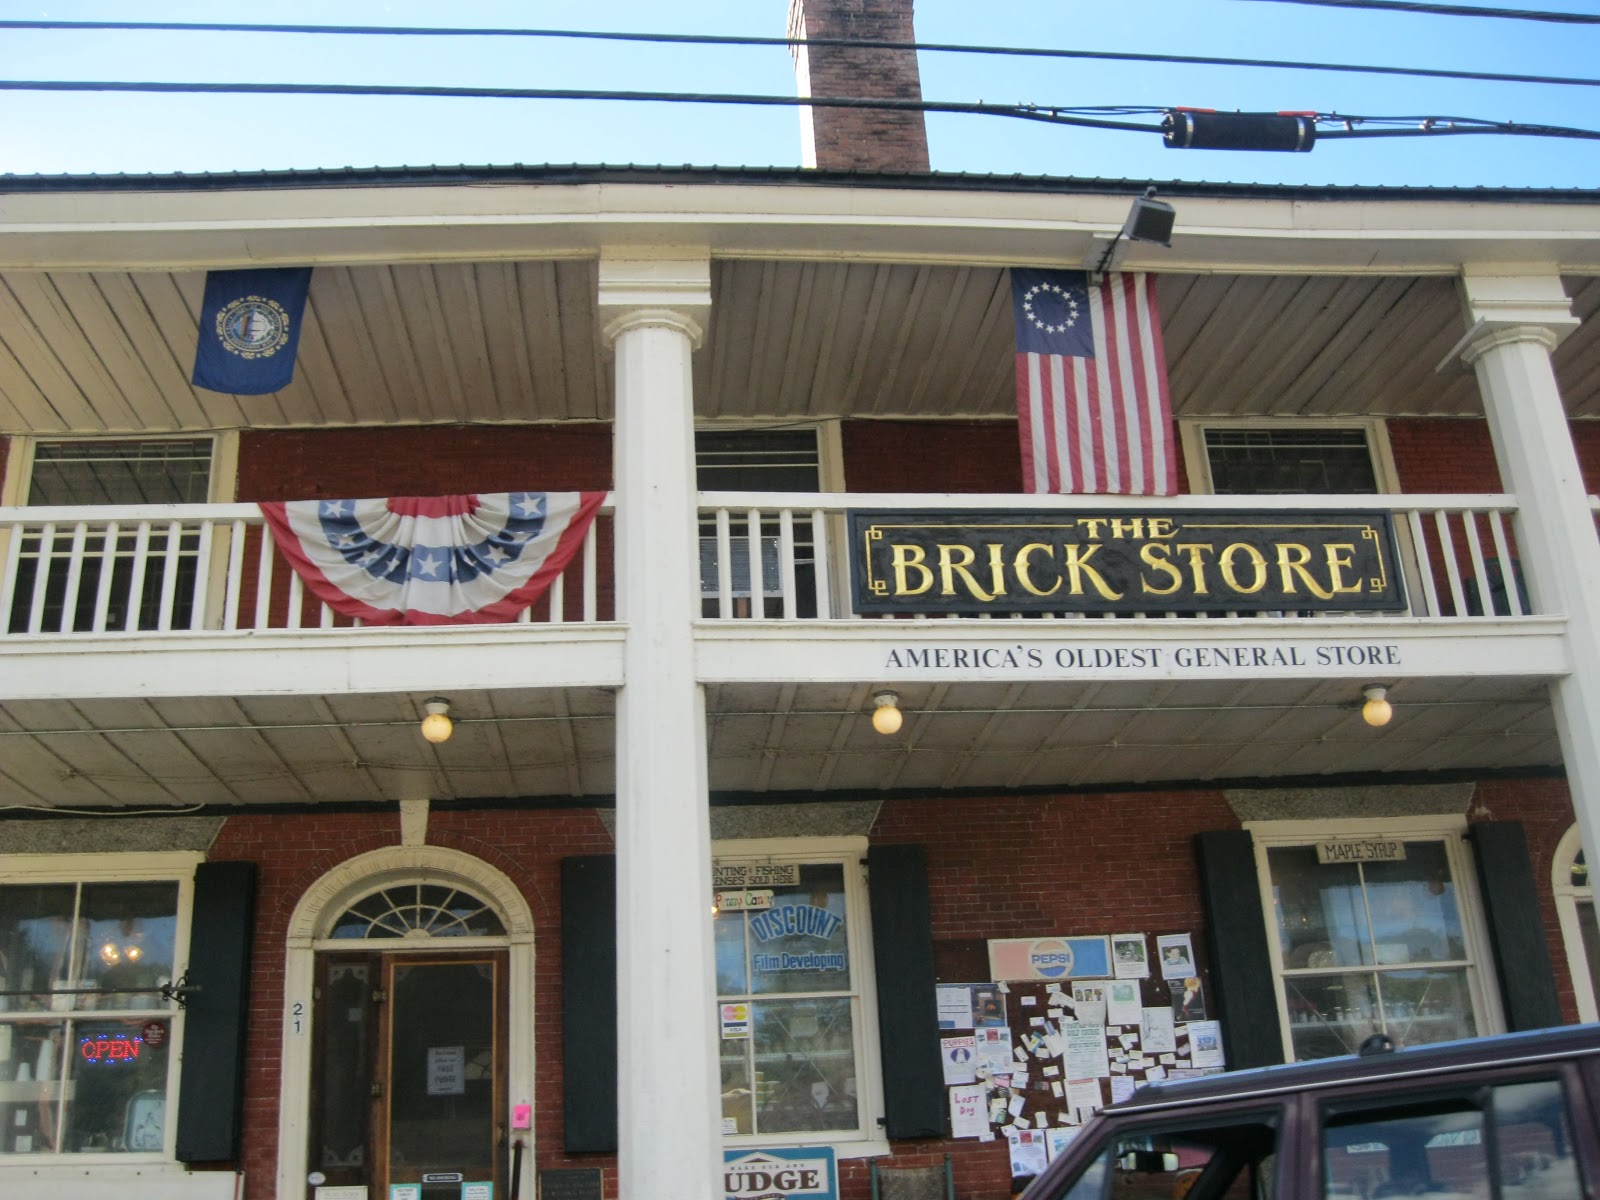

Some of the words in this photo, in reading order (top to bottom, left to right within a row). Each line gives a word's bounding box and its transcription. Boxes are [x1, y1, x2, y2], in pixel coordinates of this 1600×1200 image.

[1077, 518, 1180, 539] THE
[890, 543, 1124, 601] BRICK
[1139, 542, 1363, 600] STORE
[885, 645, 1043, 669] AMERICA'S
[1055, 647, 1161, 669] OLDEST
[1174, 646, 1306, 668] GENERAL
[1317, 645, 1401, 666] STORE
[1325, 843, 1363, 859] MAPLE
[1366, 842, 1397, 858] SYRUP
[712, 865, 746, 877] NTING
[755, 864, 794, 876] FISHING
[712, 876, 745, 887] ENSES
[749, 875, 770, 886] SOLD
[773, 874, 794, 884] HERE
[716, 894, 743, 908] Pnny
[745, 892, 774, 907] Cany
[751, 904, 842, 942] DISCOUNT
[753, 953, 780, 970] Film
[782, 951, 844, 971] Developing
[1032, 953, 1070, 964] PEPSI
[81, 1040, 140, 1059] OPEN
[943, 1037, 975, 1047] PUPPIES
[724, 1169, 820, 1193] UDGE
